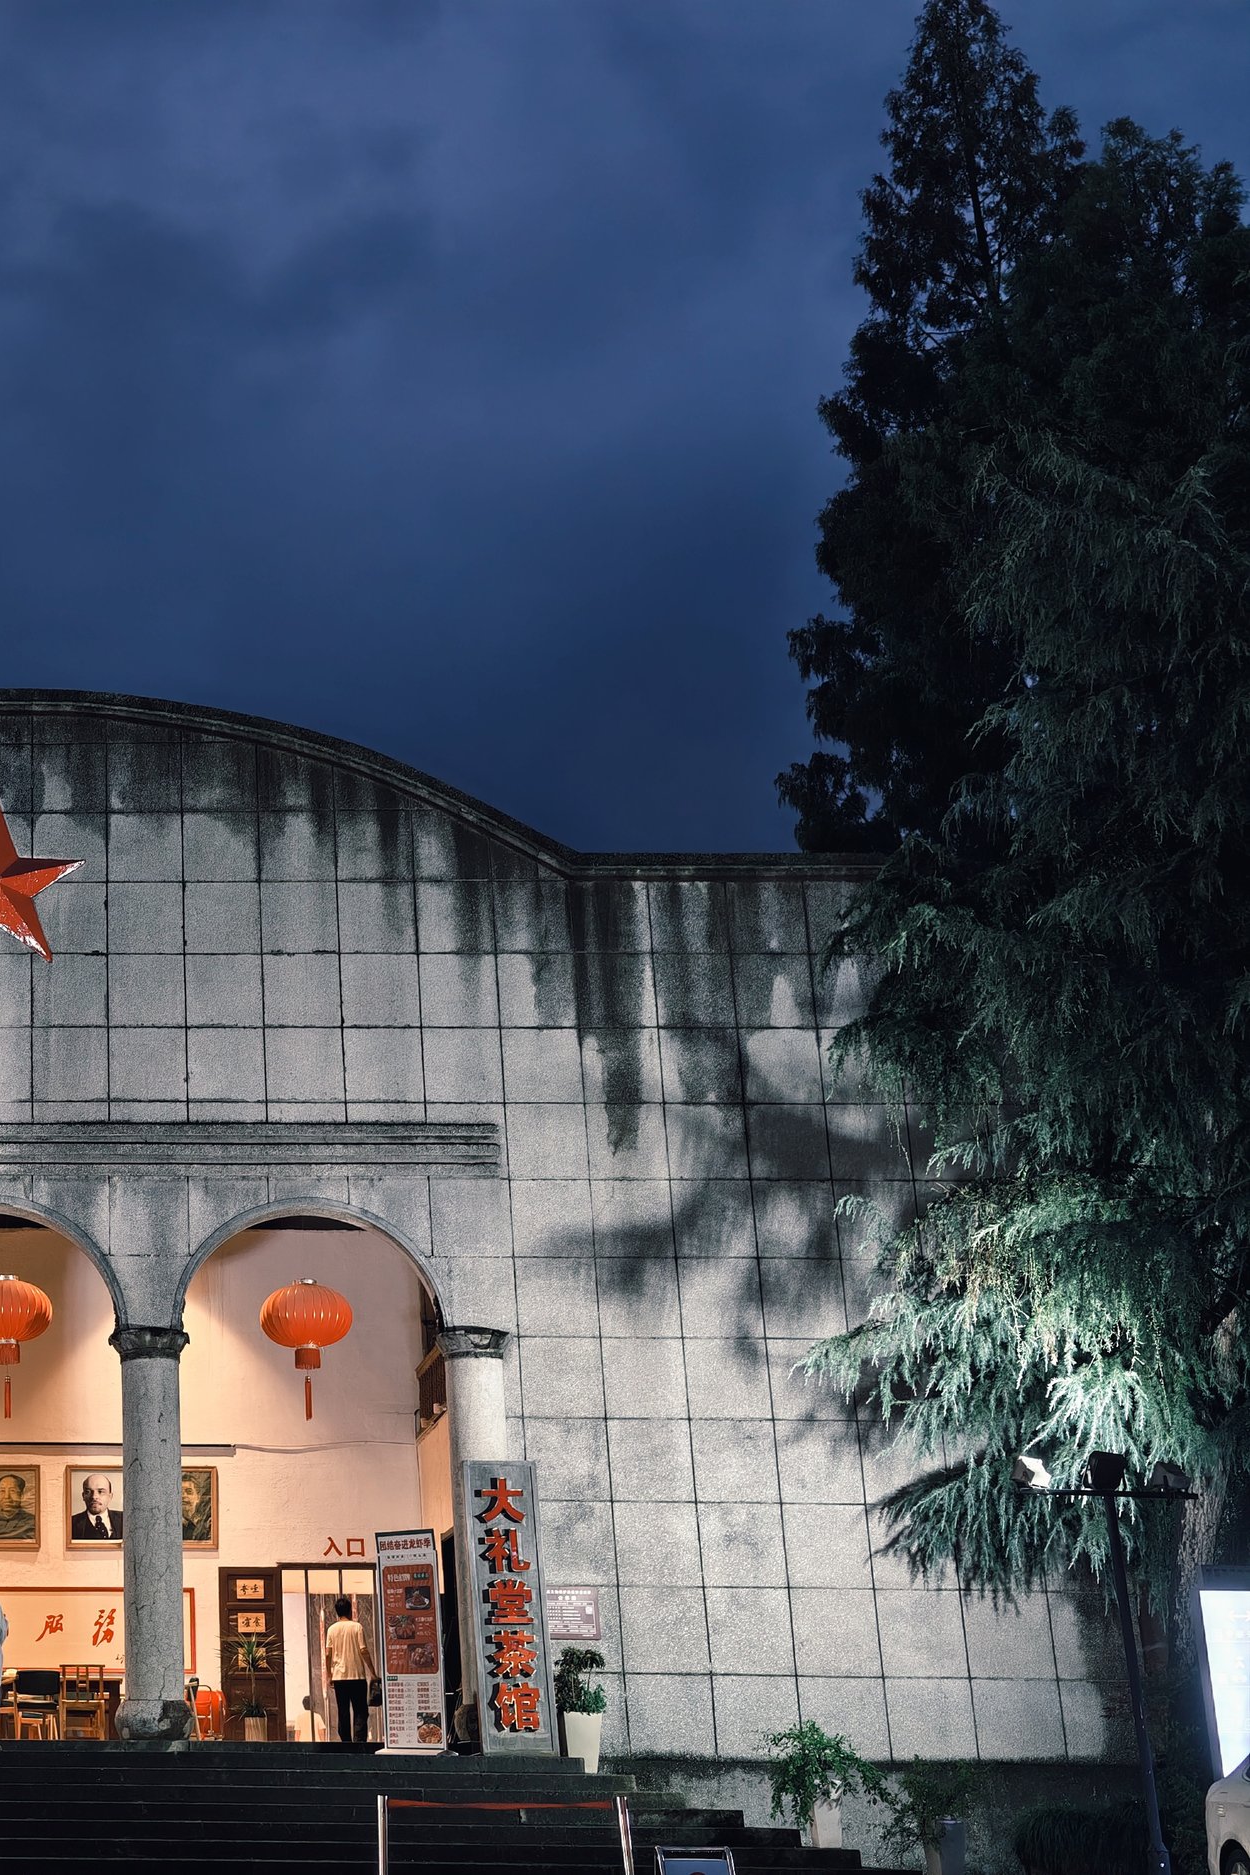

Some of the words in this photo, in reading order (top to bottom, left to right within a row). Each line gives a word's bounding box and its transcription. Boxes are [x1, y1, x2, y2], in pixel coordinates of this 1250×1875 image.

[323, 1536, 365, 1556] 入口
[380, 1537, 432, 1551] 团结奋进龙虾季
[475, 1477, 540, 1732] 大礼堂茶馆
